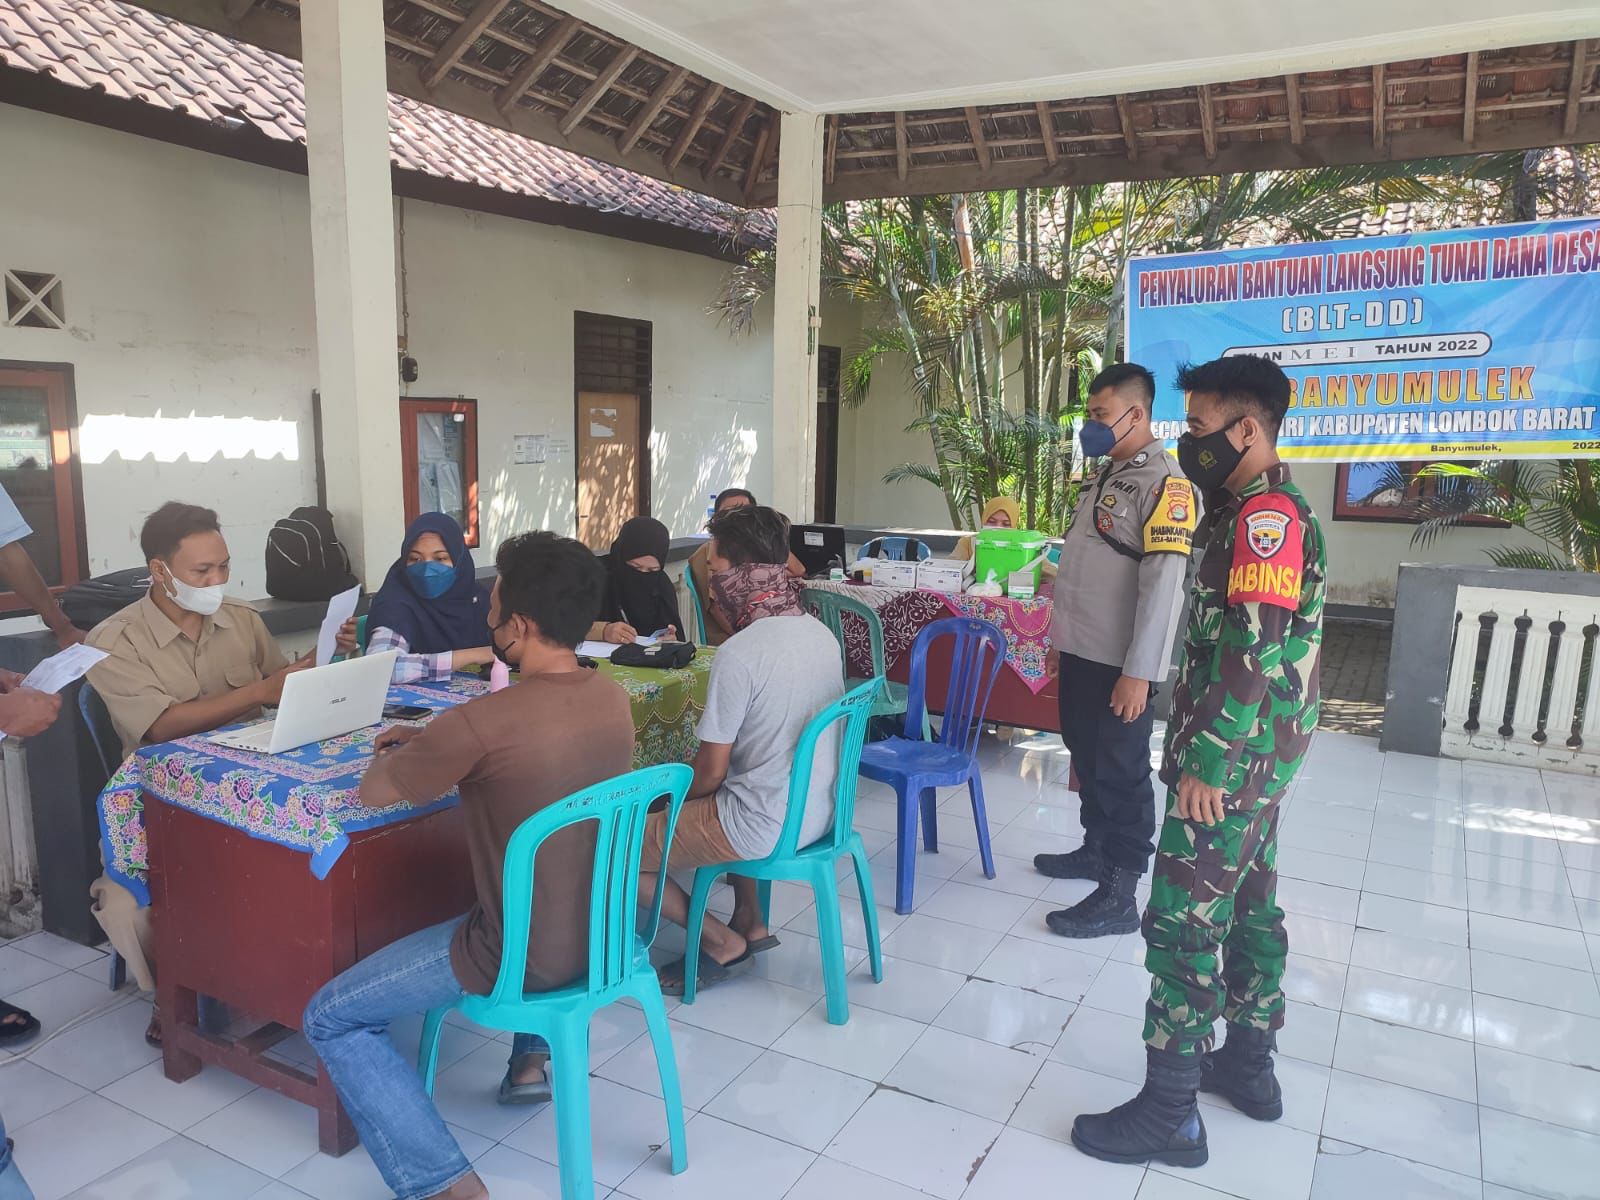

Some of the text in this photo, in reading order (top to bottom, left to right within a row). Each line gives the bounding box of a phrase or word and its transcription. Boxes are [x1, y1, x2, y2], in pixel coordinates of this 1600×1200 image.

[1139, 264, 1239, 308] PENYALURAN
[1241, 256, 1324, 301] BANTUAN
[1326, 244, 1425, 294] LANGSUNG
[1430, 238, 1489, 285] TUNAI
[1491, 233, 1548, 280] DANA
[1281, 298, 1424, 334] (BLT-DD)
[1375, 342, 1432, 356] TAHUN
[1437, 339, 1478, 351] 2022
[1288, 366, 1536, 410] BANYUMULEK
[1309, 411, 1424, 437] KABUPATEN
[1429, 408, 1518, 433] LOMBOK
[1522, 406, 1596, 430] BARAT
[1431, 444, 1502, 454] Banyumulek,
[1110, 480, 1137, 494] POLRI
